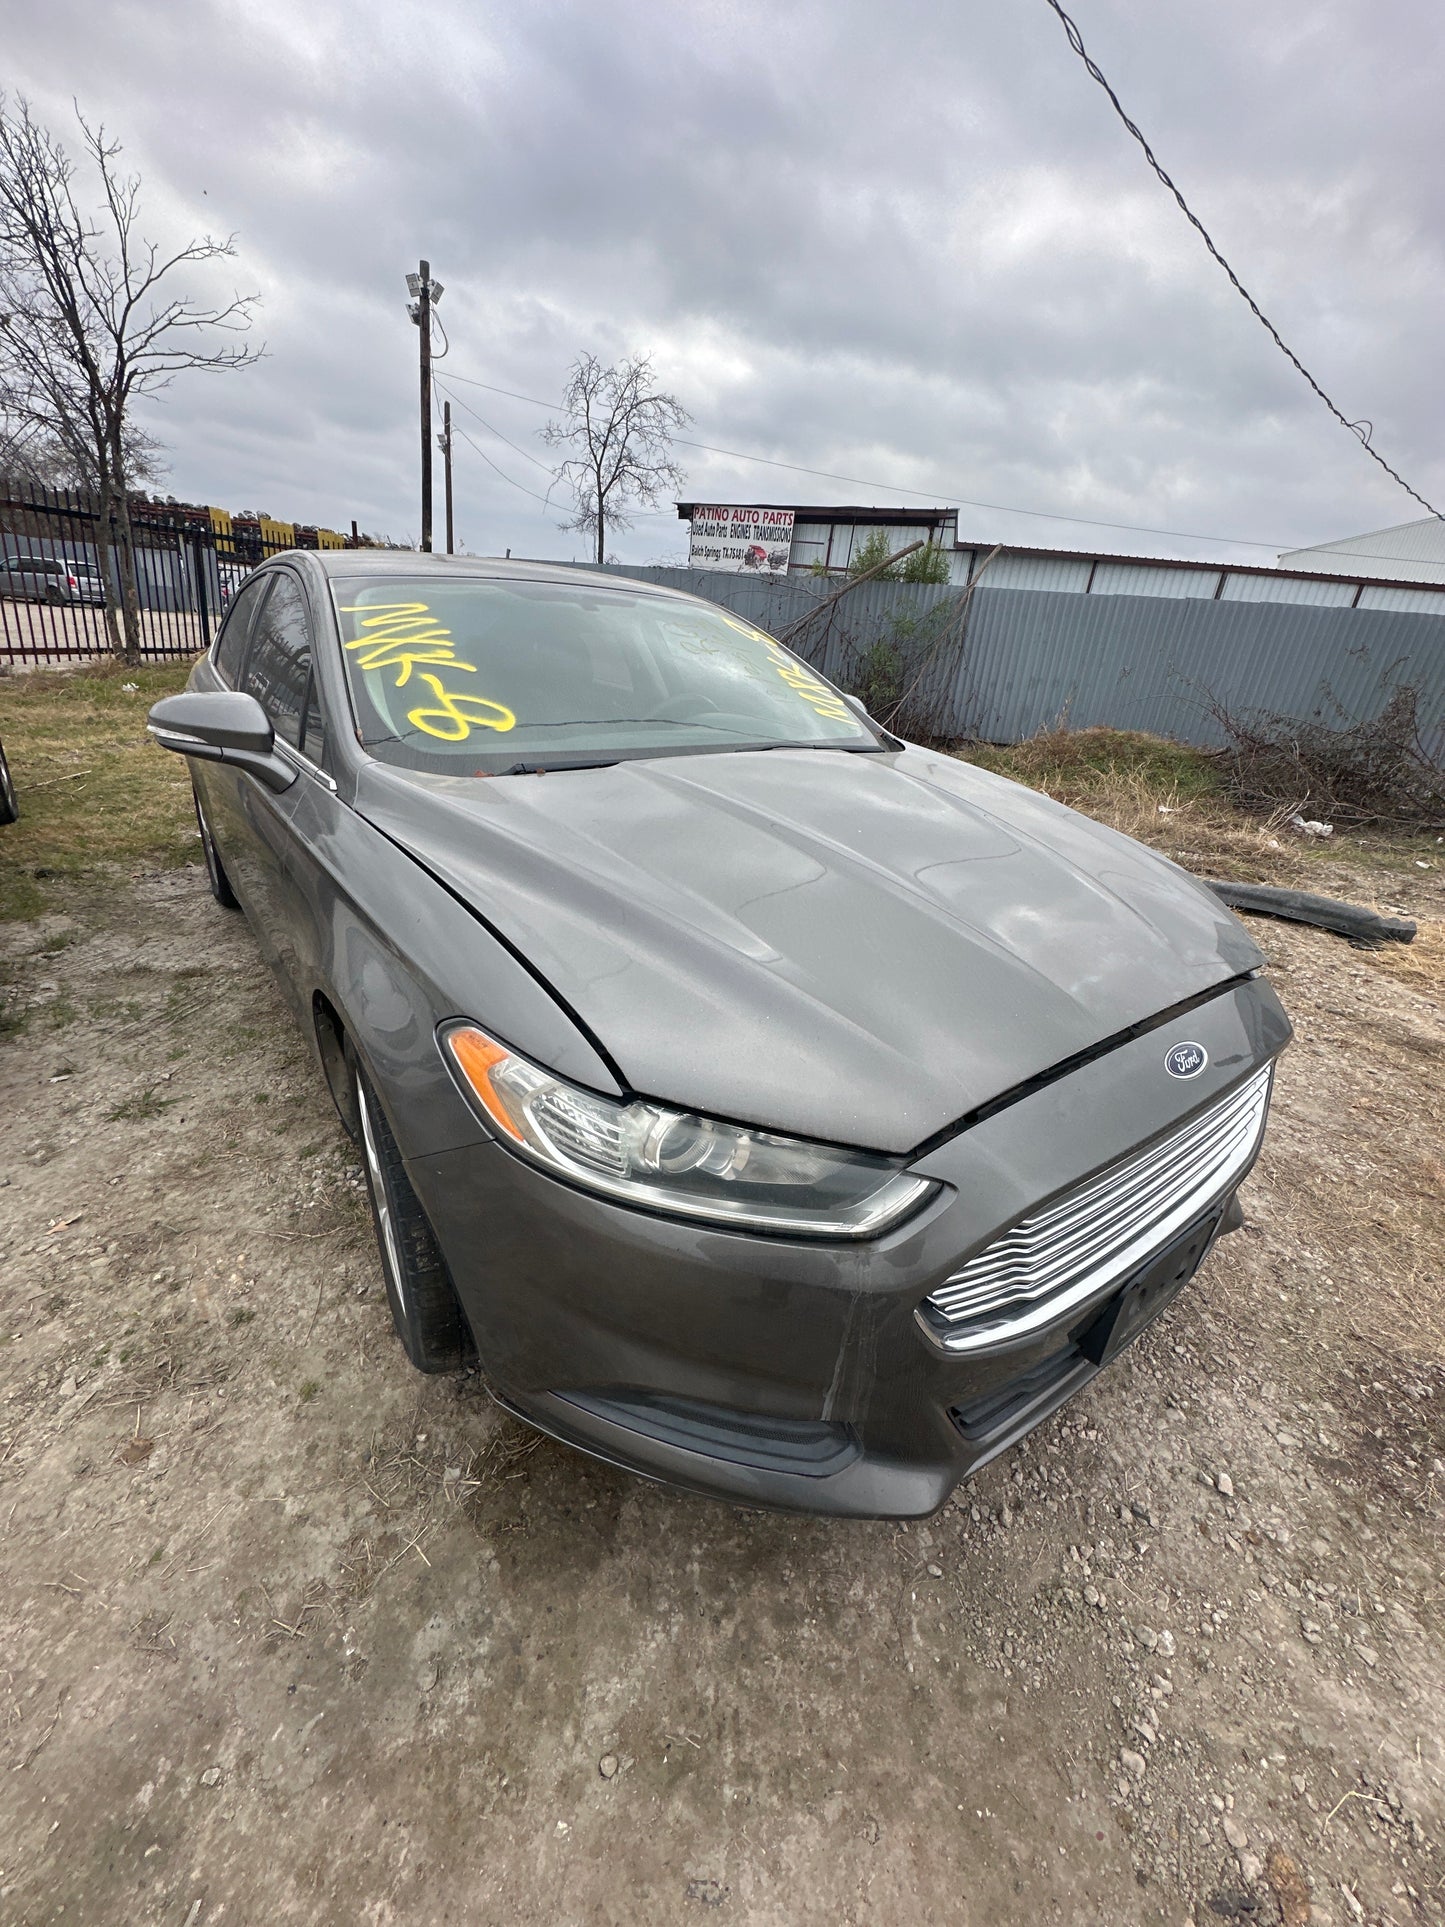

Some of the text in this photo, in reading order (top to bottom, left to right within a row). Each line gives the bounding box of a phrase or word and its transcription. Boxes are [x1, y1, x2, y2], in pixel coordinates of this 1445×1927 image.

[732, 509, 760, 524] AUTO
[762, 511, 793, 526] PARTS
[692, 521, 792, 543] Used Auto Parts ENGINES TRANSMISSIONS
[691, 544, 704, 556] Balch
[704, 546, 721, 561] Springs
[1174, 1049, 1200, 1073] Ford
